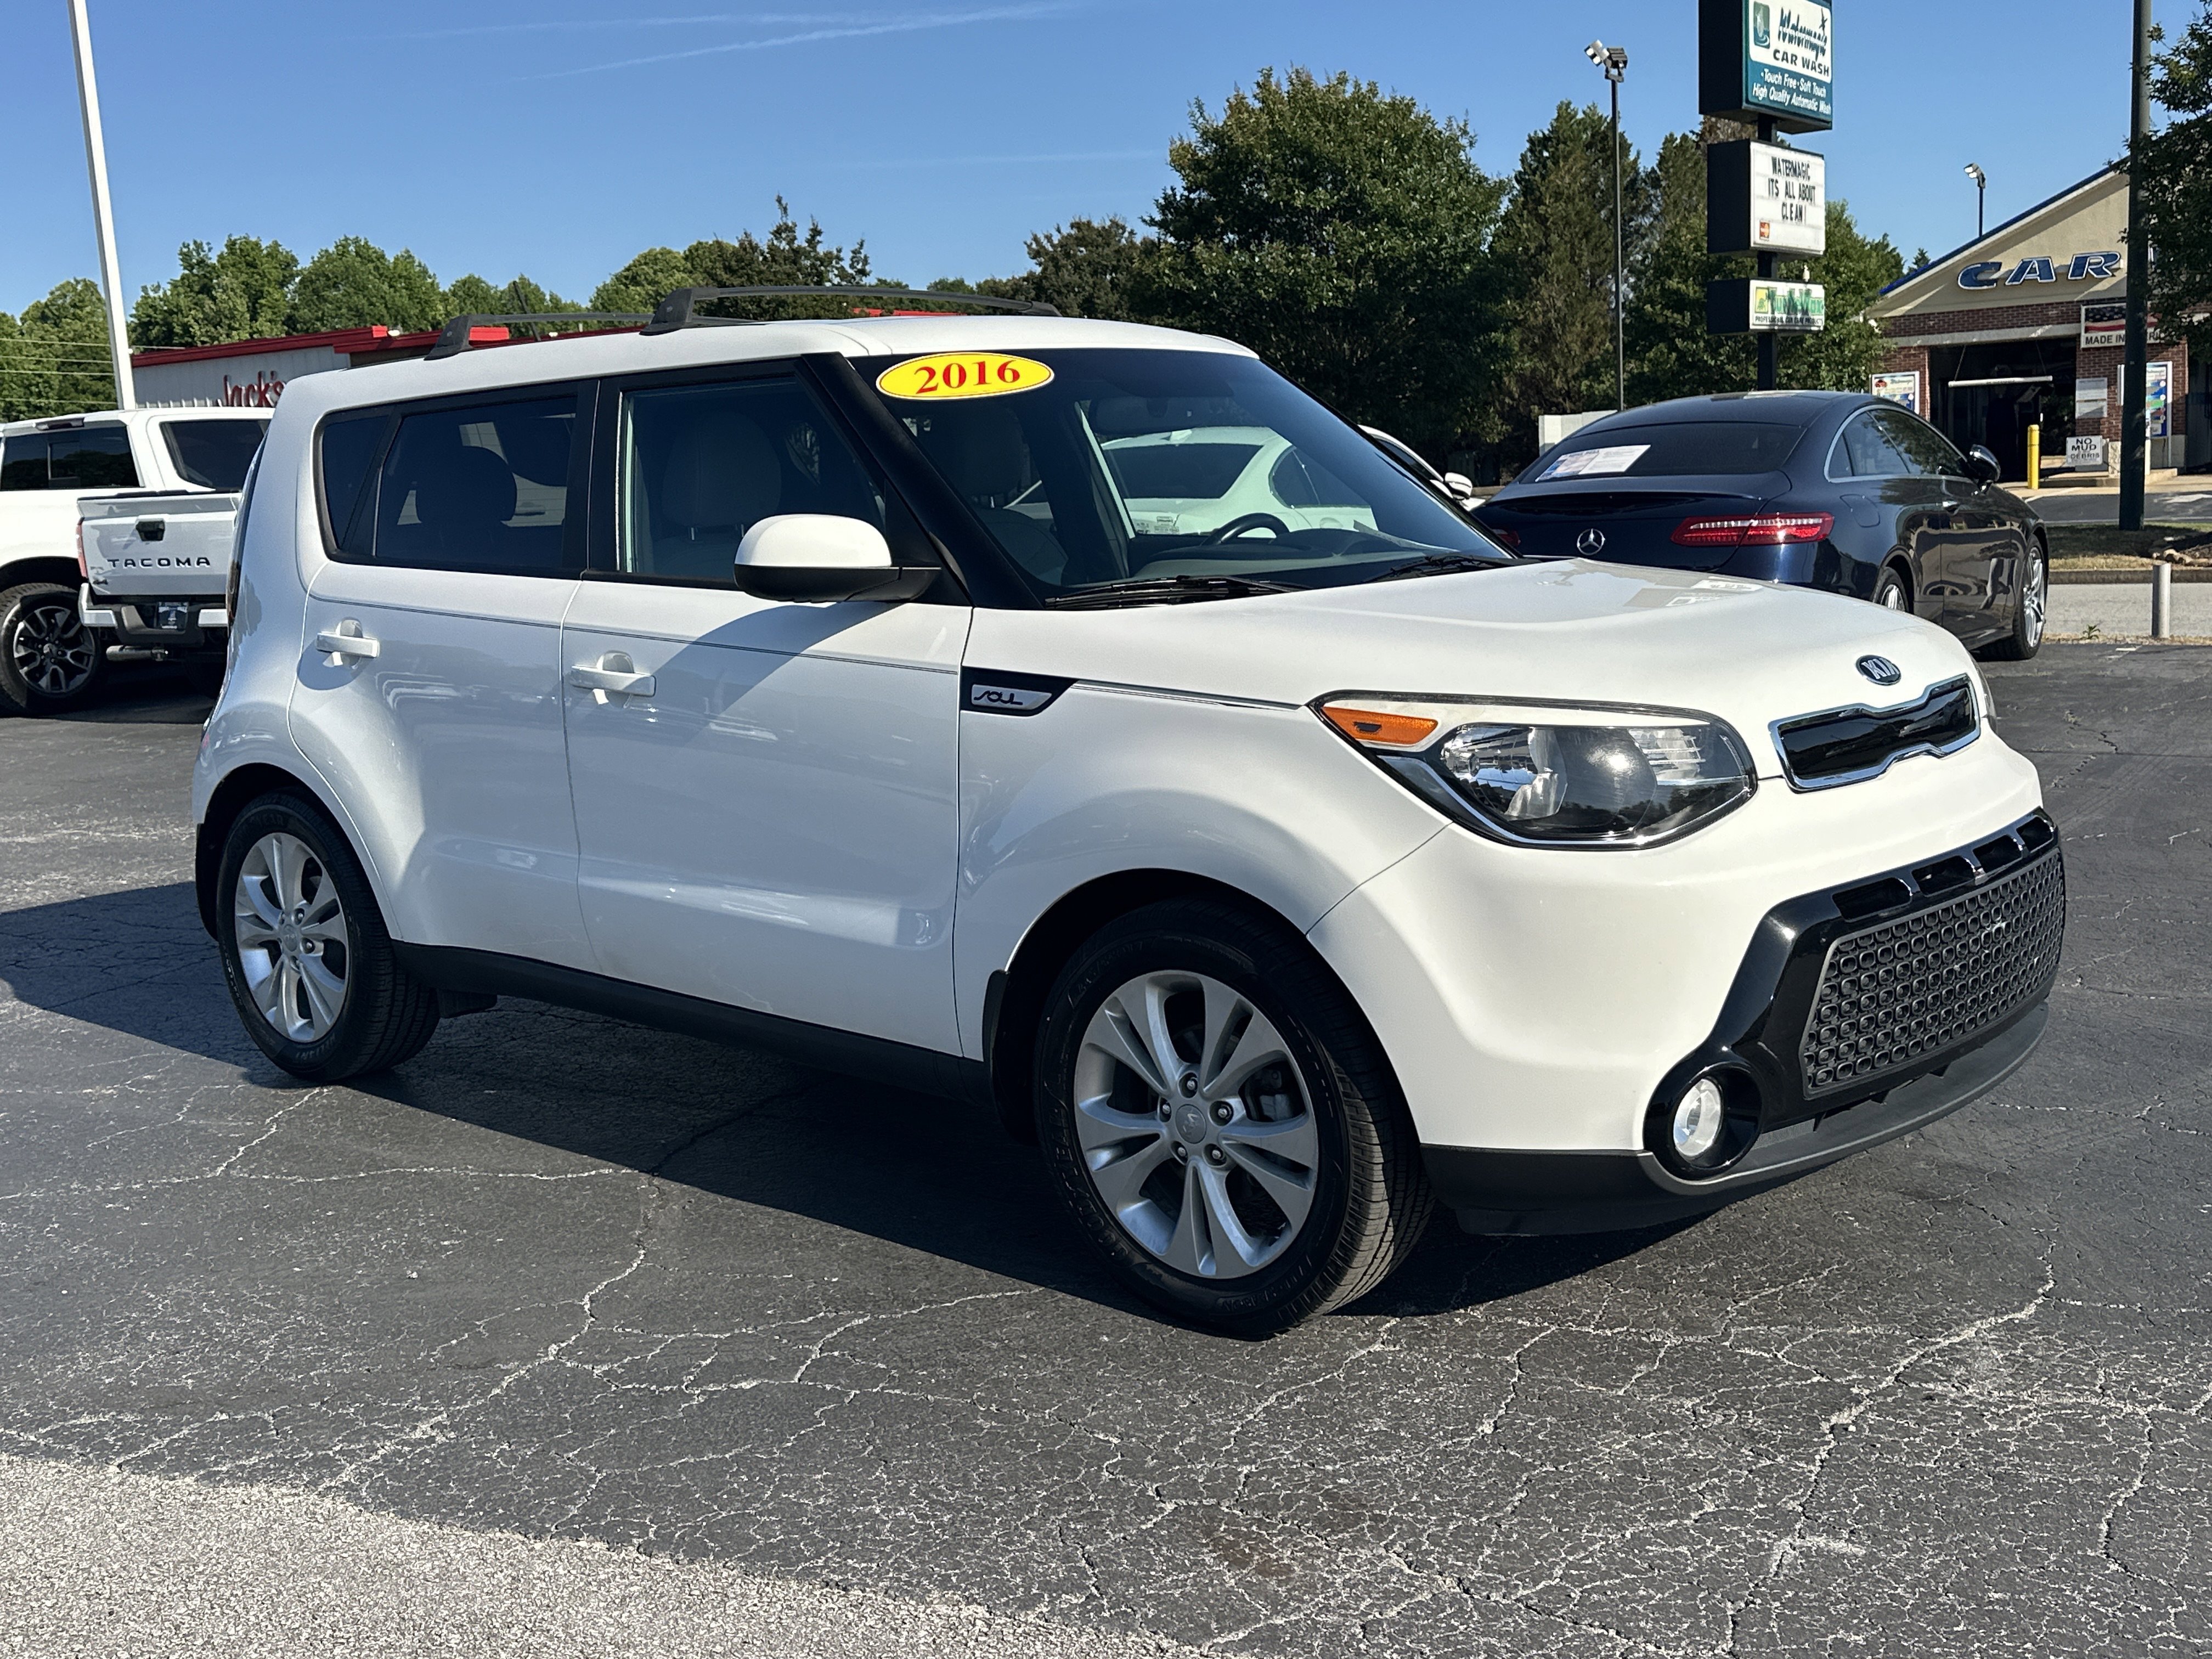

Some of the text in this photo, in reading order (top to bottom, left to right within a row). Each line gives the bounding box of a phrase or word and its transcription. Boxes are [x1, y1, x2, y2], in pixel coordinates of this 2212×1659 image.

[1773, 48, 1830, 77] CAR WASH
[1752, 82, 1768, 101] High
[1769, 86, 1791, 106] Quality
[1791, 92, 1819, 111] Automatic
[1799, 77, 1812, 94] Soft
[1812, 82, 1826, 98] Touch
[1771, 156, 1811, 181] WATERMAGIC
[1768, 178, 1816, 206] ITS ALL ABOUT
[1957, 251, 2121, 291] CAR
[2085, 334, 2125, 345] MADE IN
[914, 360, 1020, 394] 2016
[107, 557, 211, 568] TACOMA
[1861, 658, 1900, 680] KIA
